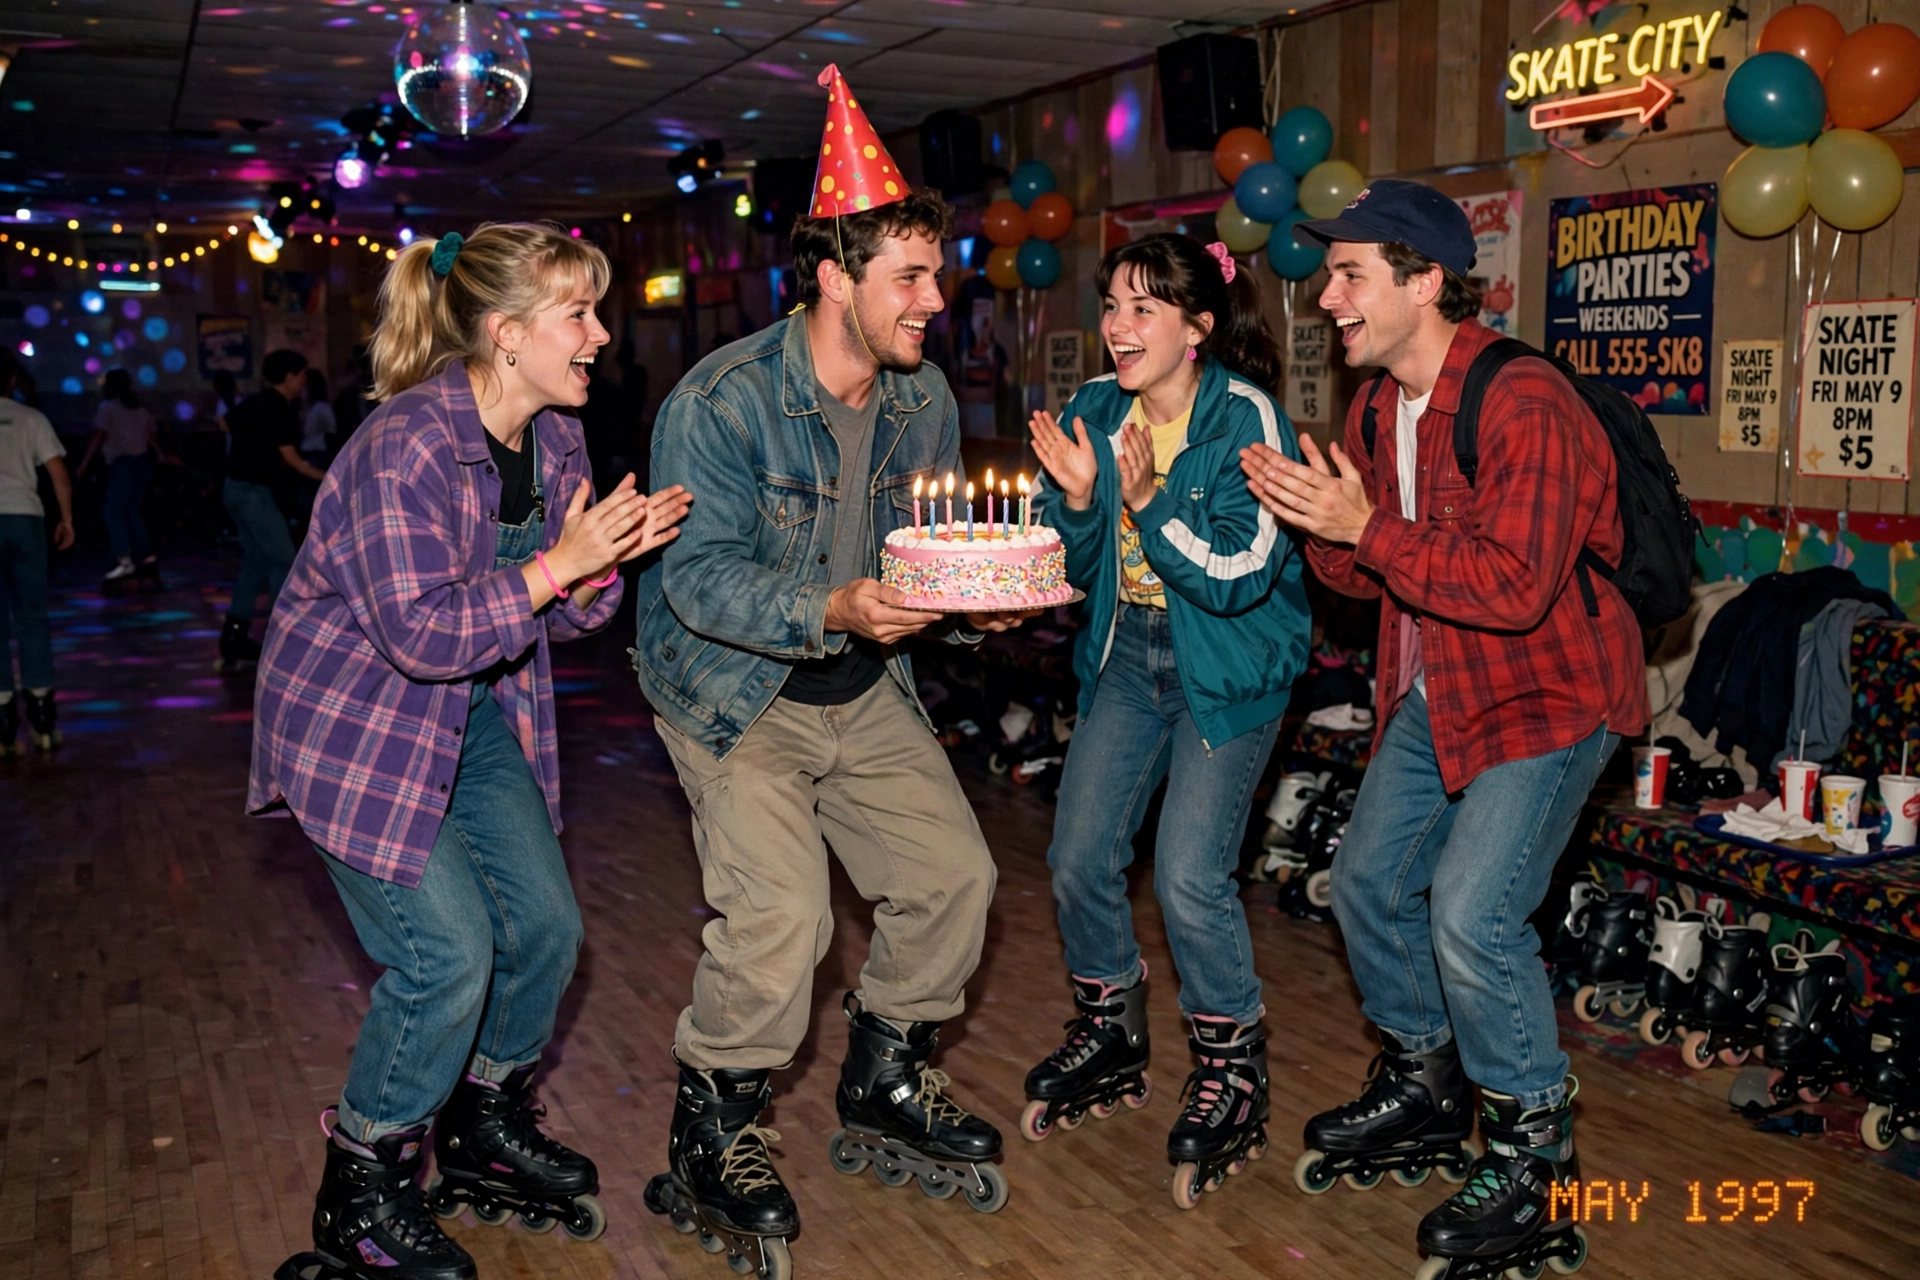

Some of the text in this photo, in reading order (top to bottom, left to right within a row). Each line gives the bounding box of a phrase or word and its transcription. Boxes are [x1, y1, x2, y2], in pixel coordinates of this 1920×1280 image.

[1505, 10, 1722, 101] SKATE CITY
[1555, 200, 1705, 270] BIRTHDAY
[1577, 250, 1691, 304] PARTIES
[1578, 304, 1669, 333] WEEKENDS
[1818, 314, 1898, 345] SKATE
[1293, 323, 1326, 342] SKATE
[1606, 336, 1704, 376] 555-SK8
[1730, 349, 1773, 367] SKATE
[1818, 347, 1896, 376] NIGHT
[1731, 369, 1772, 387] NIGHT
[1726, 389, 1777, 404] FRI MAY 9
[1811, 380, 1903, 404] FRI MAY 9
[1303, 397, 1318, 418] $5
[1738, 406, 1760, 421] 8PM
[1832, 406, 1873, 431] 8PM
[1741, 424, 1761, 446] $5
[1839, 434, 1874, 470] $5
